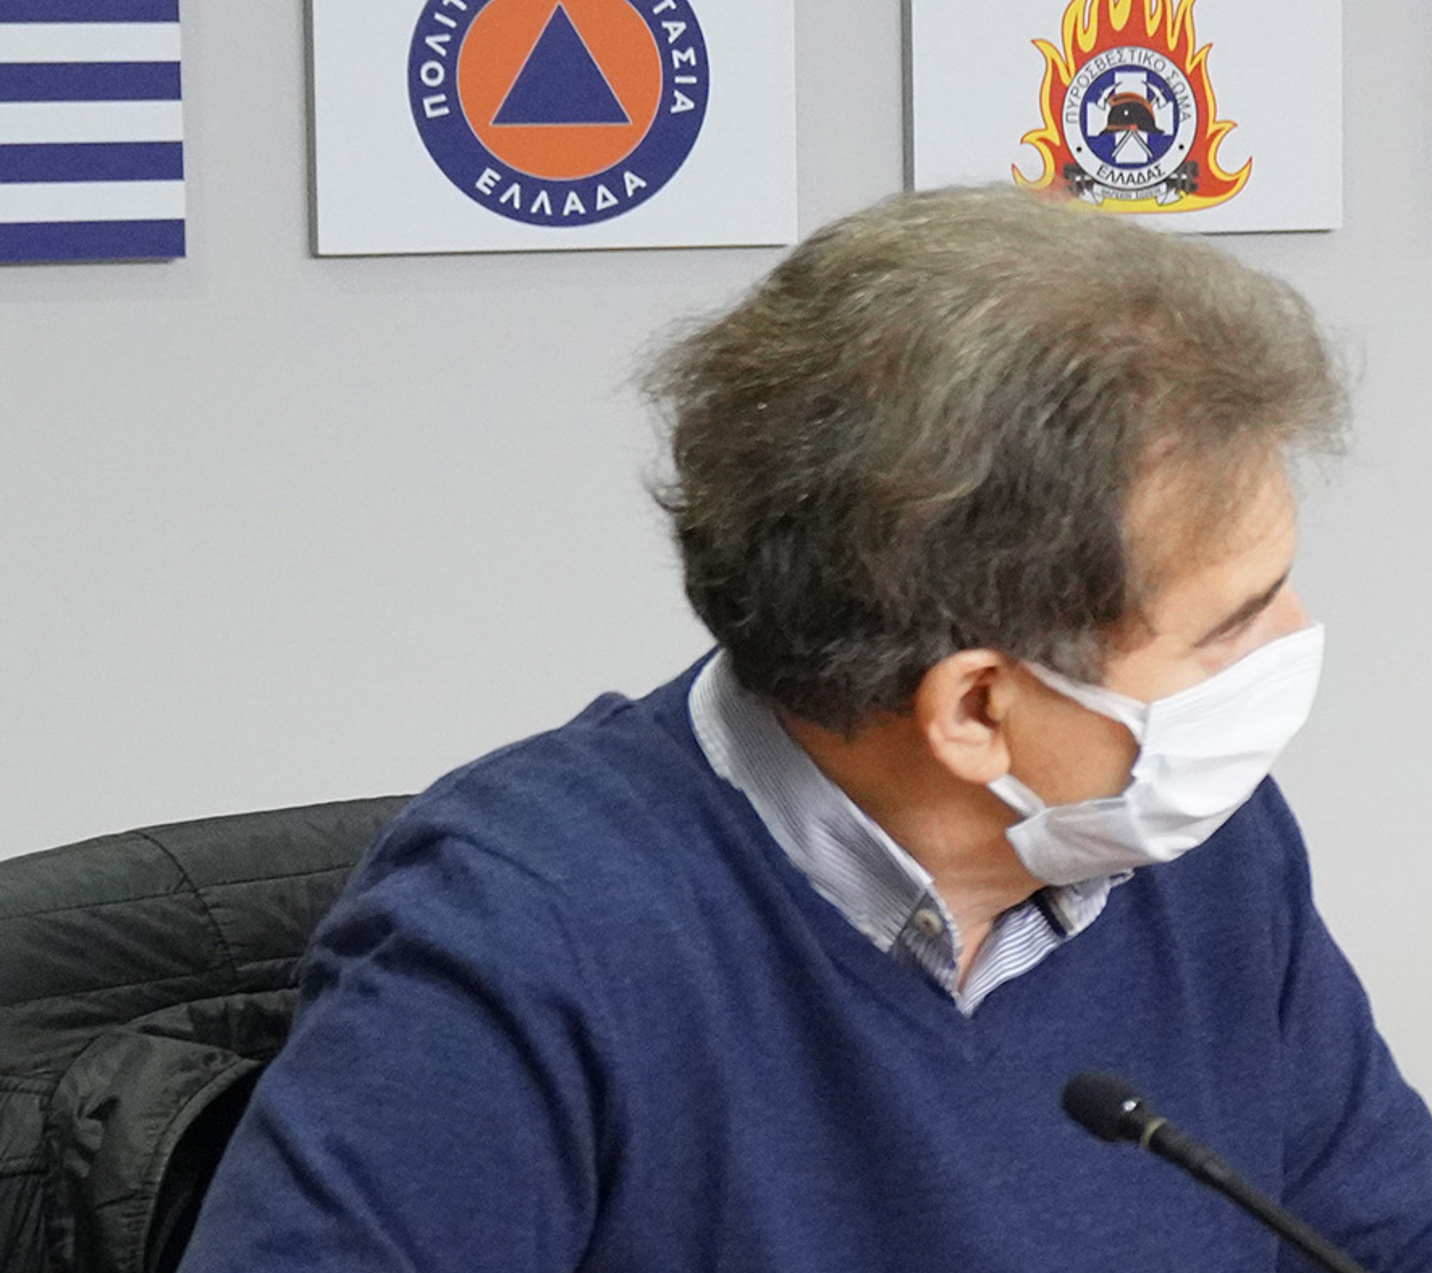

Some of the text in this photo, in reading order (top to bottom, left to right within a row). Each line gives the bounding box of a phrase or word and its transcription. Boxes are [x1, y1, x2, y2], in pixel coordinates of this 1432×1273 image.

[1065, 49, 1192, 124] ΠΥΡΟΣΒΕΣΤΙΚΟ ΣΩΜΑ
[475, 167, 647, 216] ΕΛΛΑΔΑ
[1096, 164, 1166, 185] ΕΛΛΑΔΑΣ
